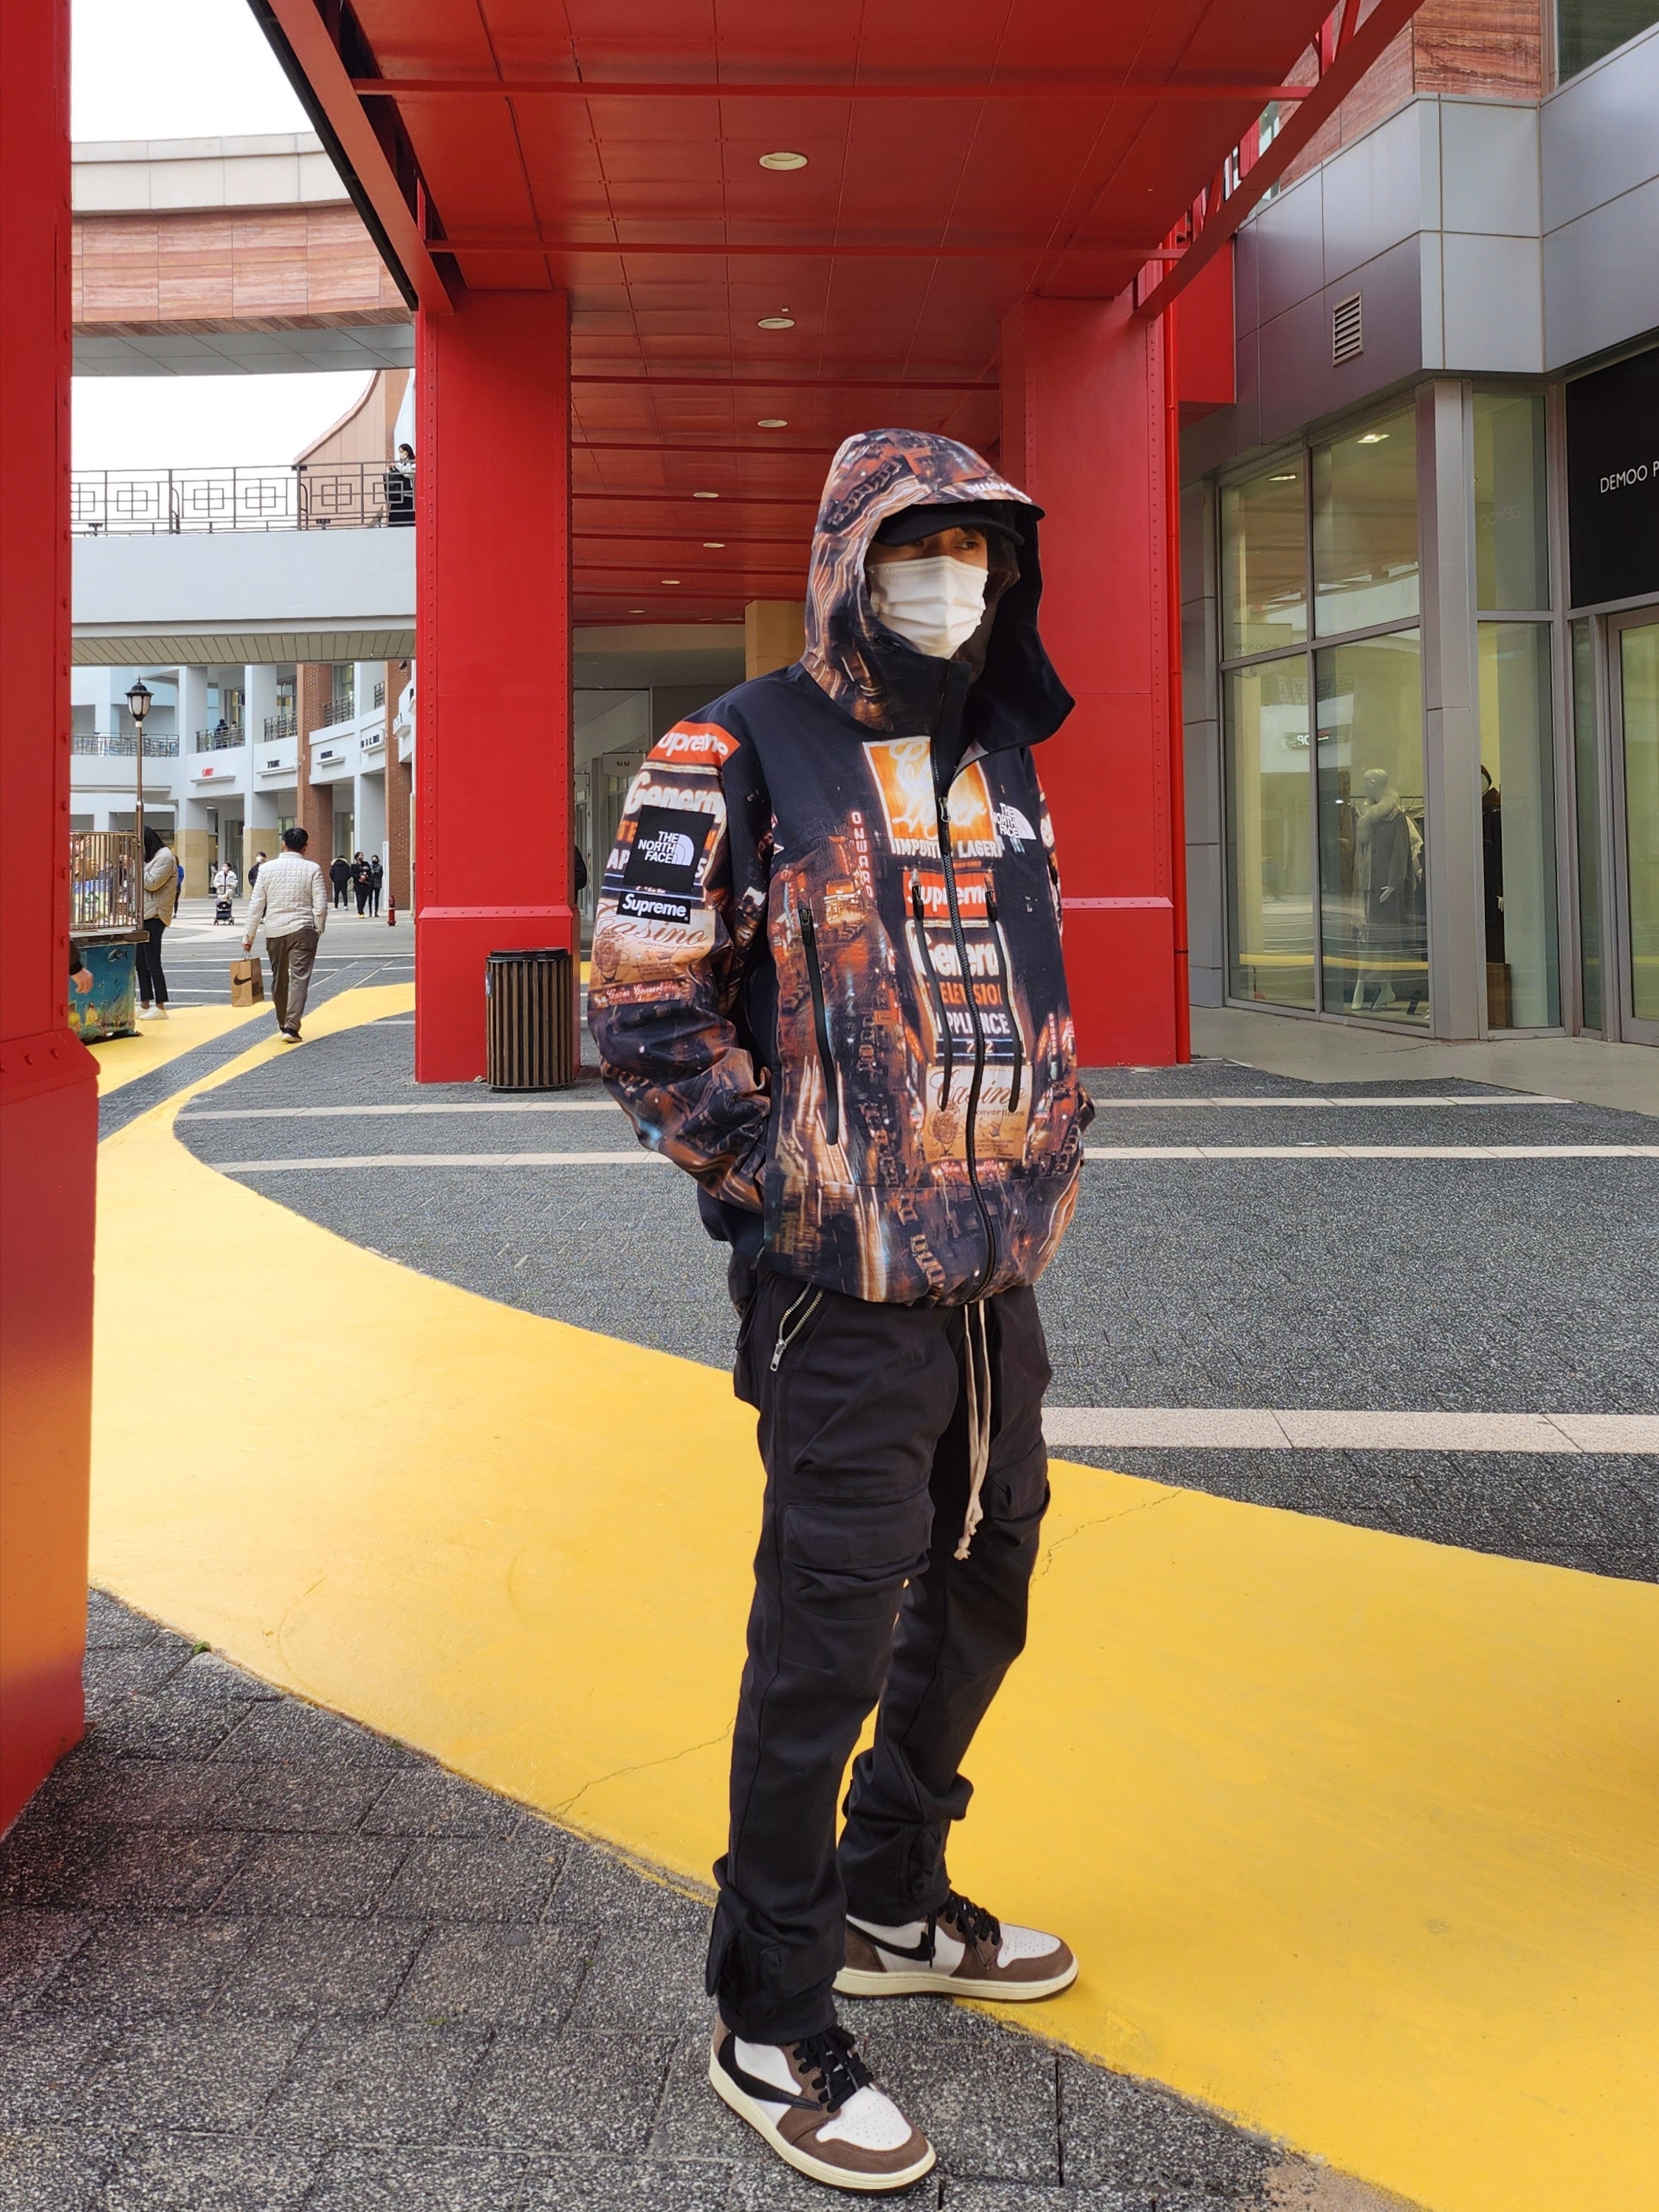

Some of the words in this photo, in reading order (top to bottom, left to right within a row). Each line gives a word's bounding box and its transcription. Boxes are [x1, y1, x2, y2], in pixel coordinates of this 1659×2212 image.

[1600, 464, 1648, 494] DEMOO
[656, 732, 729, 758] upreme
[999, 802, 1014, 817] THE
[992, 811, 1016, 828] NORTH
[658, 831, 680, 844] THE
[999, 825, 1020, 838] FACE
[637, 839, 676, 853] NORTH
[644, 851, 674, 864] FACE
[622, 893, 687, 917] Supreme
[912, 930, 1000, 977] Genera
